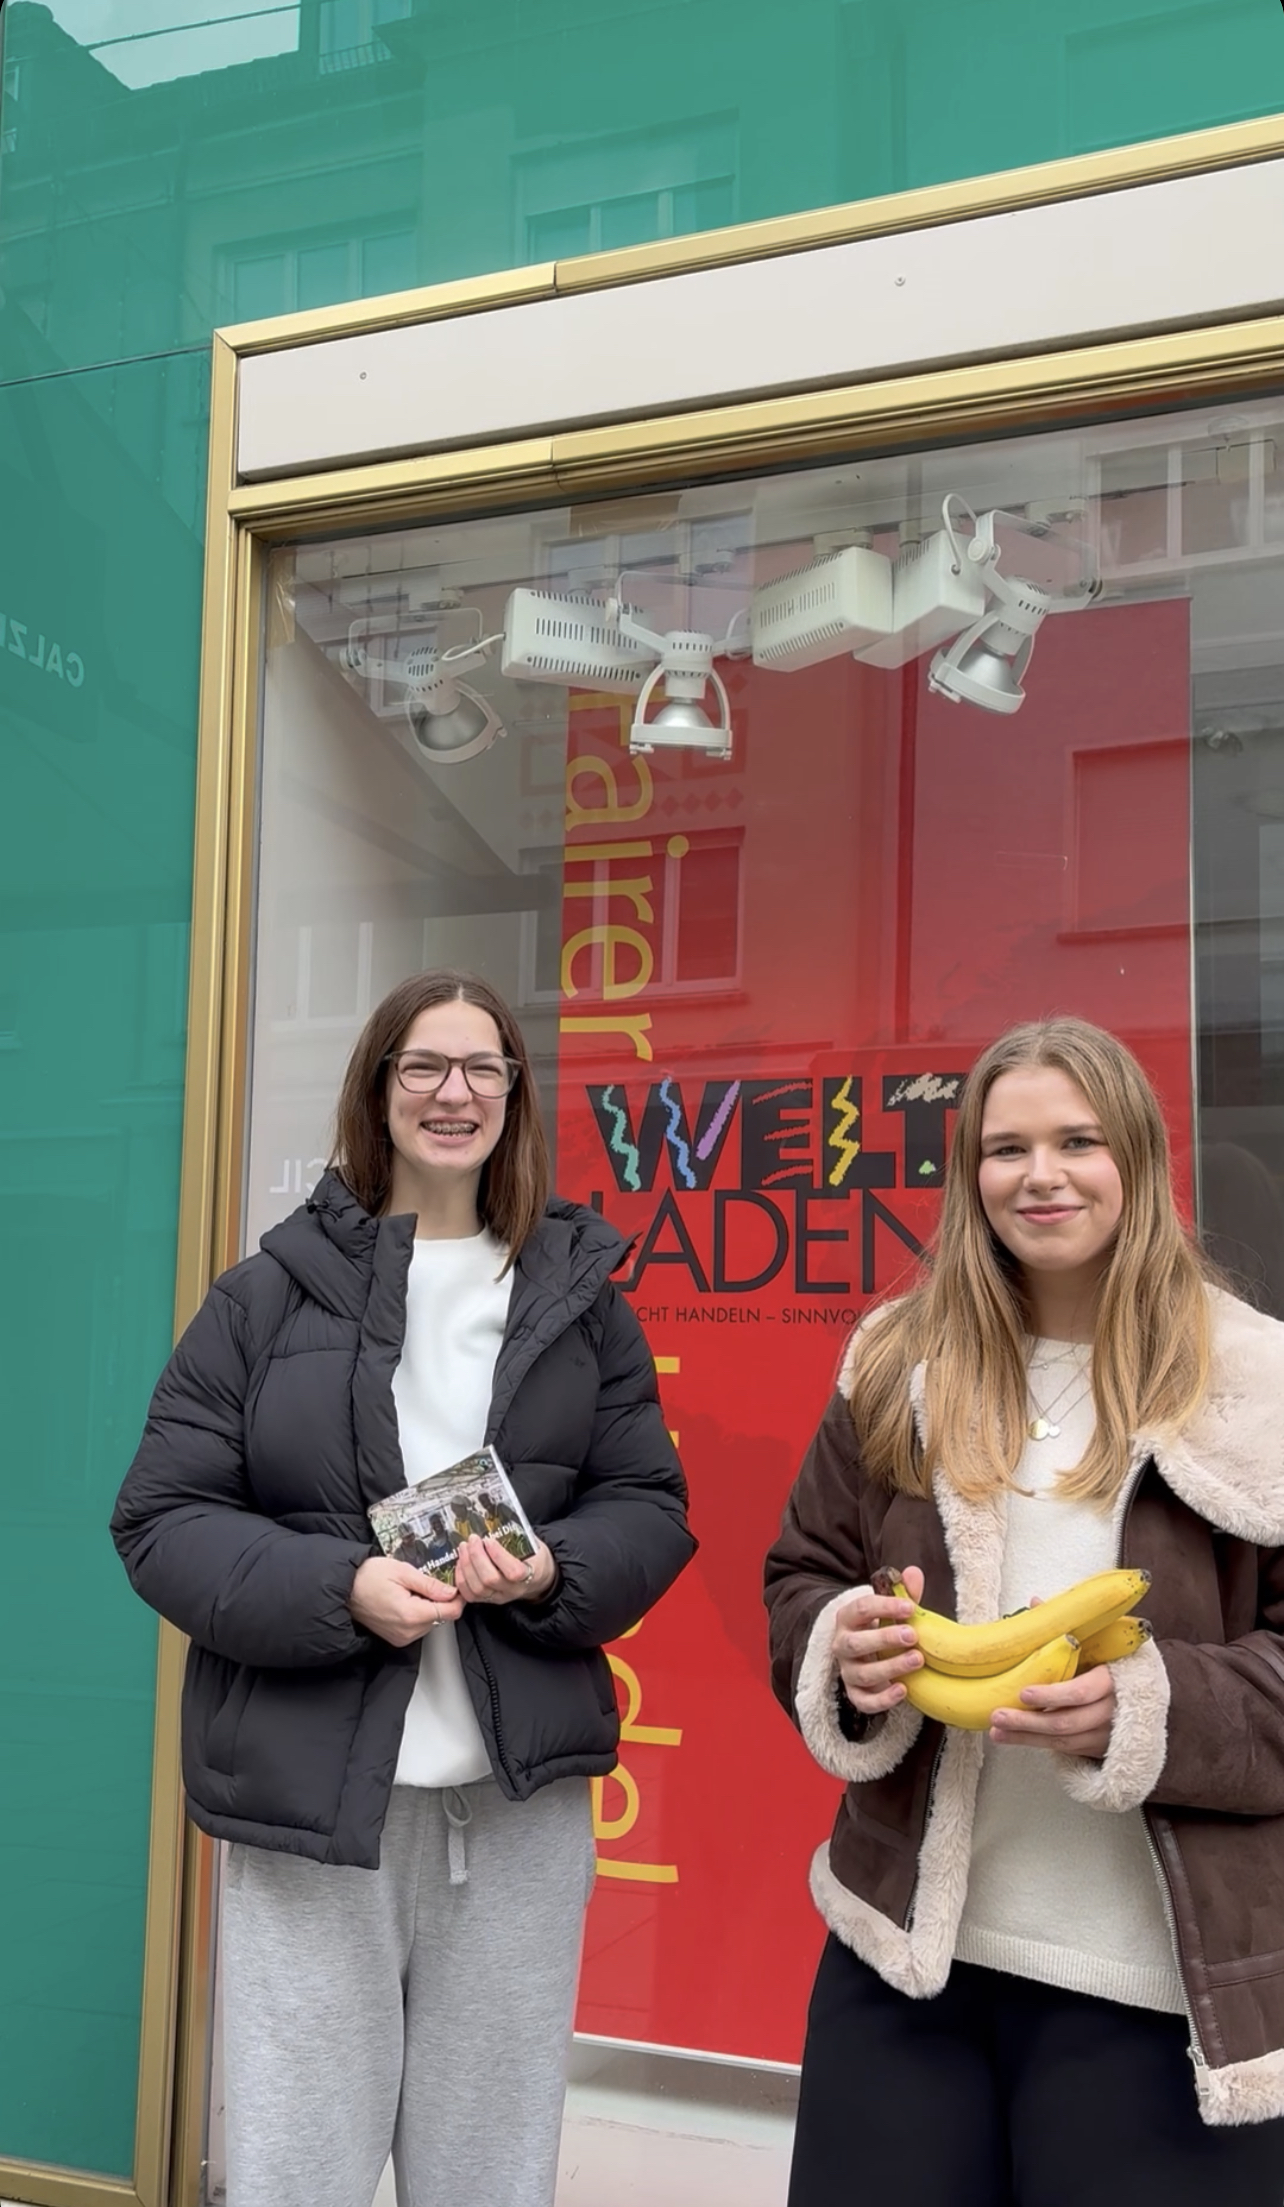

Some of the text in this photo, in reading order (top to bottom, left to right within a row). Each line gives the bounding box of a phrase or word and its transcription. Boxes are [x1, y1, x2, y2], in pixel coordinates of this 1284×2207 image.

[585, 1073, 965, 1193] WELT
[636, 1306, 669, 1323] CHT
[675, 1306, 760, 1324] HANDELN
[427, 1548, 458, 1570] Handel
